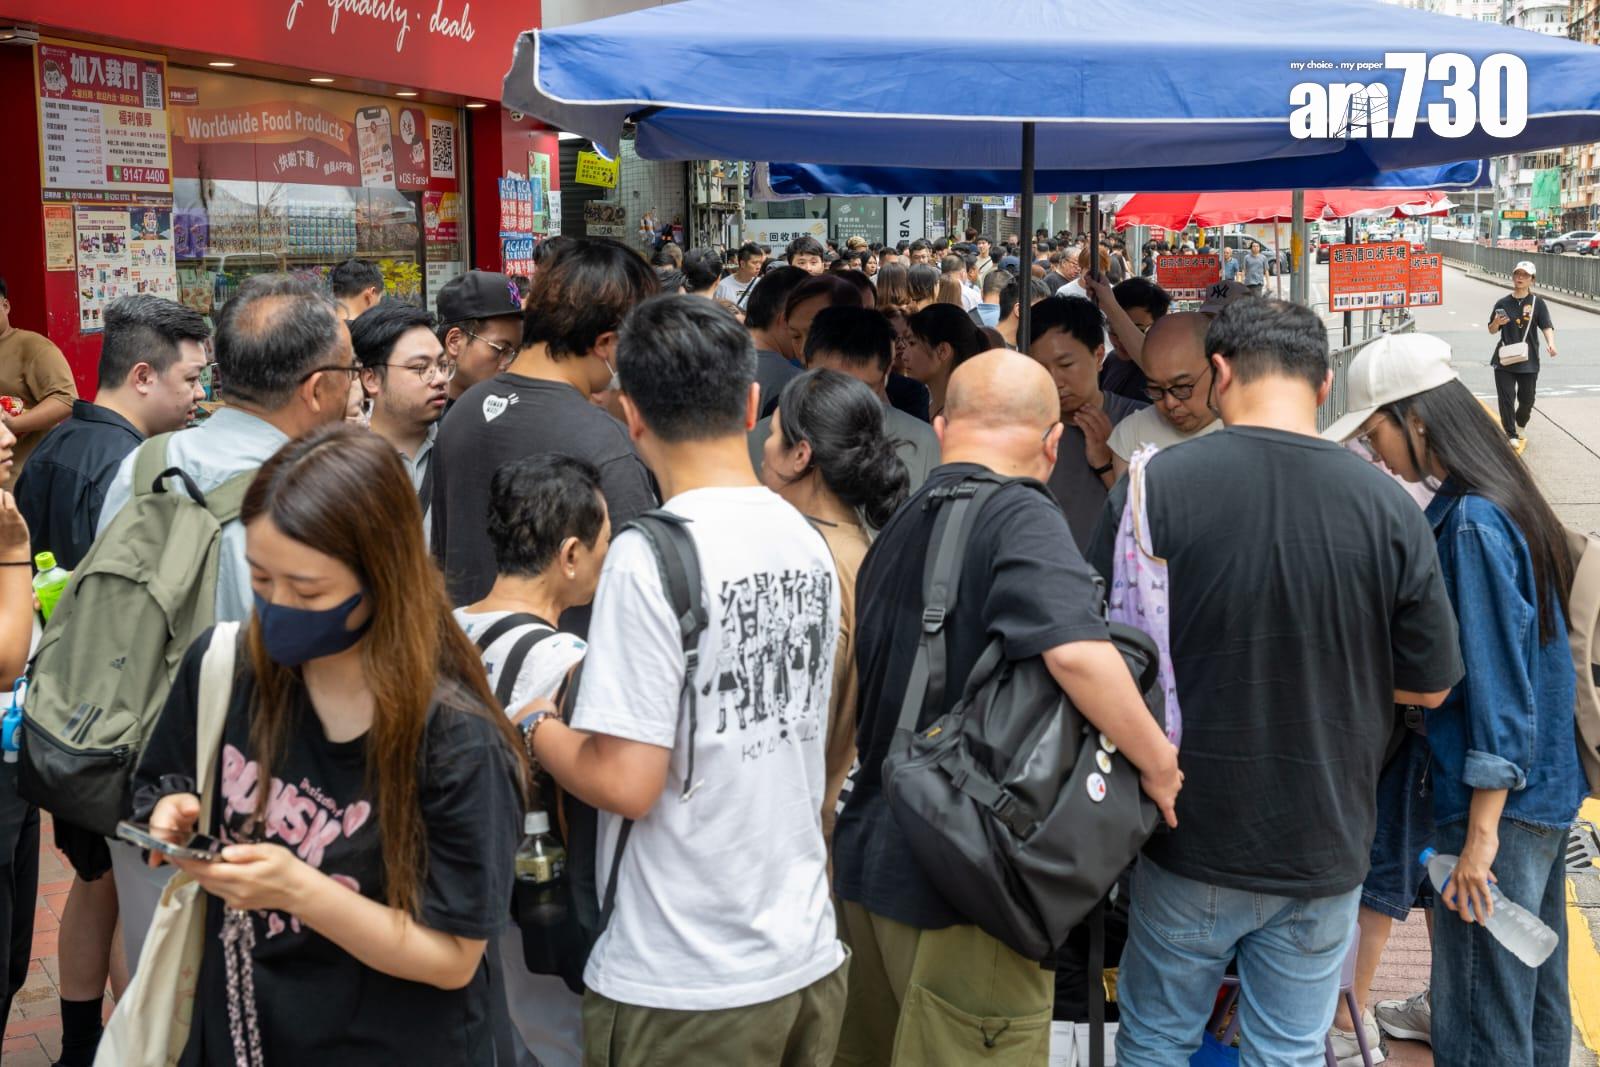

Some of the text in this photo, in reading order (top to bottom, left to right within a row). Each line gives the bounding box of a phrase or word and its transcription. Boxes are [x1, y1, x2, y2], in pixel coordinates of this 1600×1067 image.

[429, 0, 475, 42] deals
[69, 52, 138, 91] 加入我們
[187, 110, 344, 142] Worldwide Food Products
[123, 167, 165, 182] 9147 4400
[501, 180, 516, 192] ACA
[517, 181, 531, 193] ACA
[1334, 245, 1407, 263] 超高價回收手機
[1411, 256, 1439, 269] 收手機
